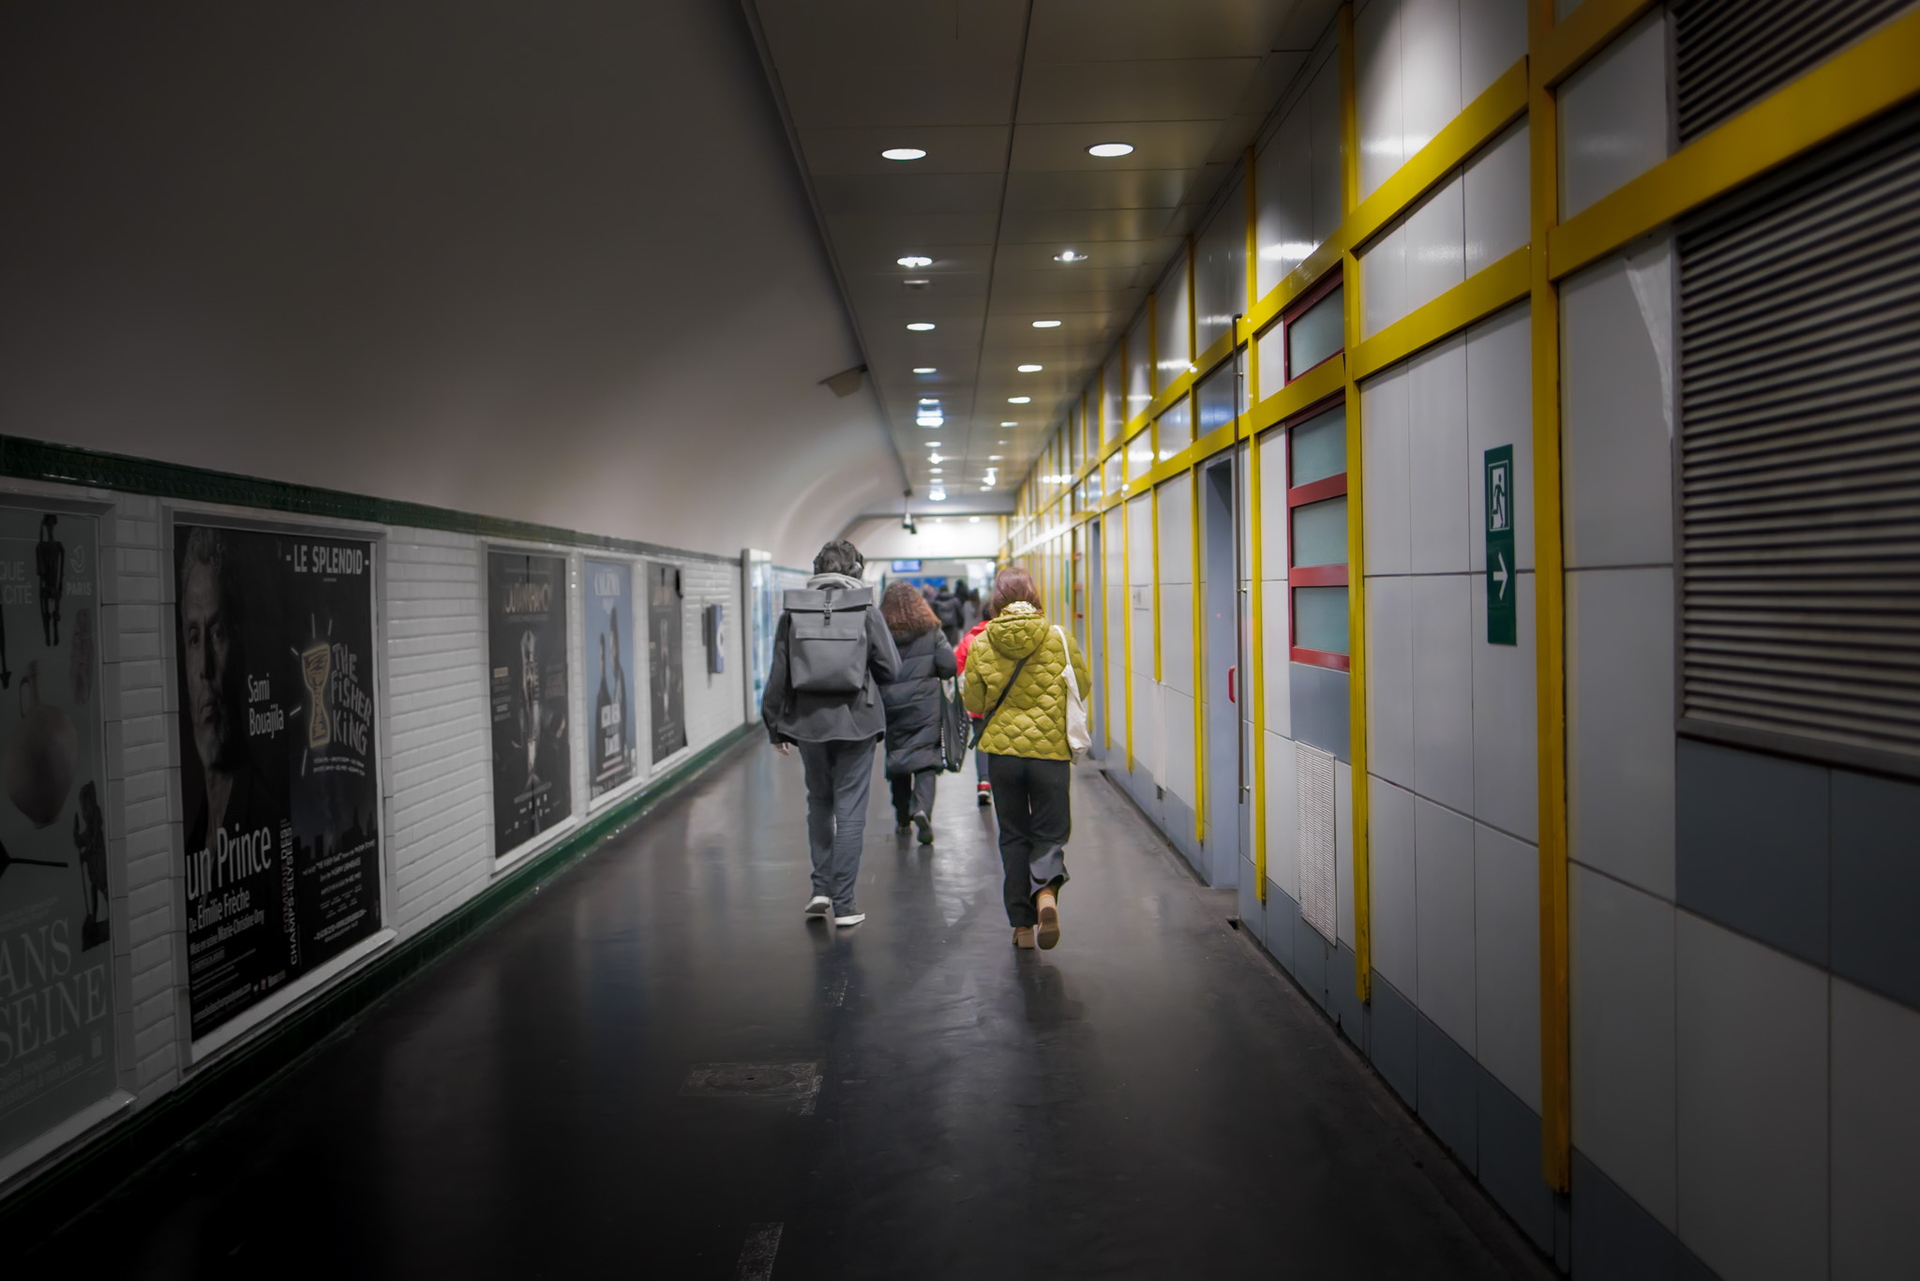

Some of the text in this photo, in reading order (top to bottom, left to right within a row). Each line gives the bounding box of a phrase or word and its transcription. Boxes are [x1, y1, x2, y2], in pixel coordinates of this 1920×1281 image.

[293, 544, 363, 575] LE SPLENDID
[3, 581, 33, 605] CITÉ
[66, 582, 92, 596] PARIS
[332, 643, 358, 683] THE
[247, 673, 270, 703] Sami
[186, 847, 213, 901] un
[216, 822, 272, 888] Prince
[0, 917, 71, 998] ANS
[0, 963, 106, 1068] SEINE
